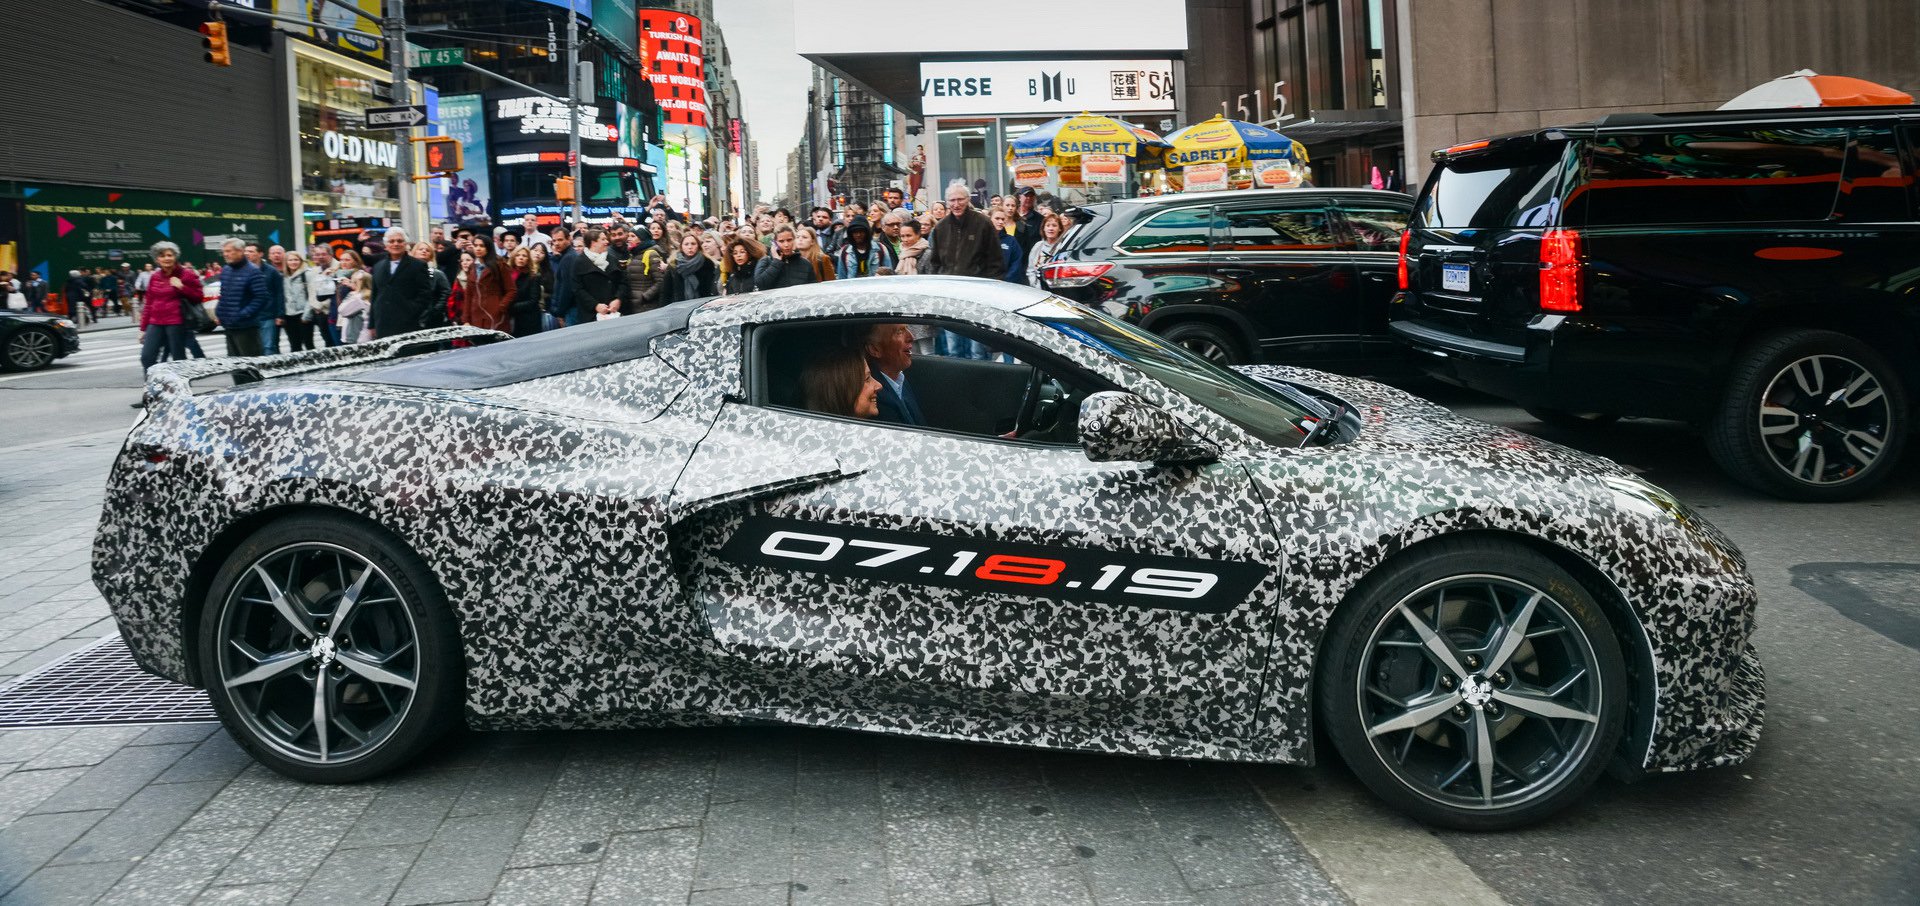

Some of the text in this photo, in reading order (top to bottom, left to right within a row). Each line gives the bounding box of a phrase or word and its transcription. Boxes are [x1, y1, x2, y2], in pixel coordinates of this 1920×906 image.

[648, 31, 682, 41] TURKISH
[421, 52, 432, 64] W
[436, 51, 450, 64] 45
[656, 50, 689, 63] AWAITS
[648, 74, 668, 84] THE
[1150, 71, 1173, 100] SA
[1028, 78, 1075, 96] B U
[1221, 80, 1287, 123] 1515
[401, 112, 418, 121] WAY
[437, 106, 472, 119] BLESS
[323, 131, 398, 168] OLD NAV
[1060, 141, 1132, 153] SABRETT
[1169, 147, 1238, 164] SABRETT
[759, 530, 1219, 598] 07.18.19
